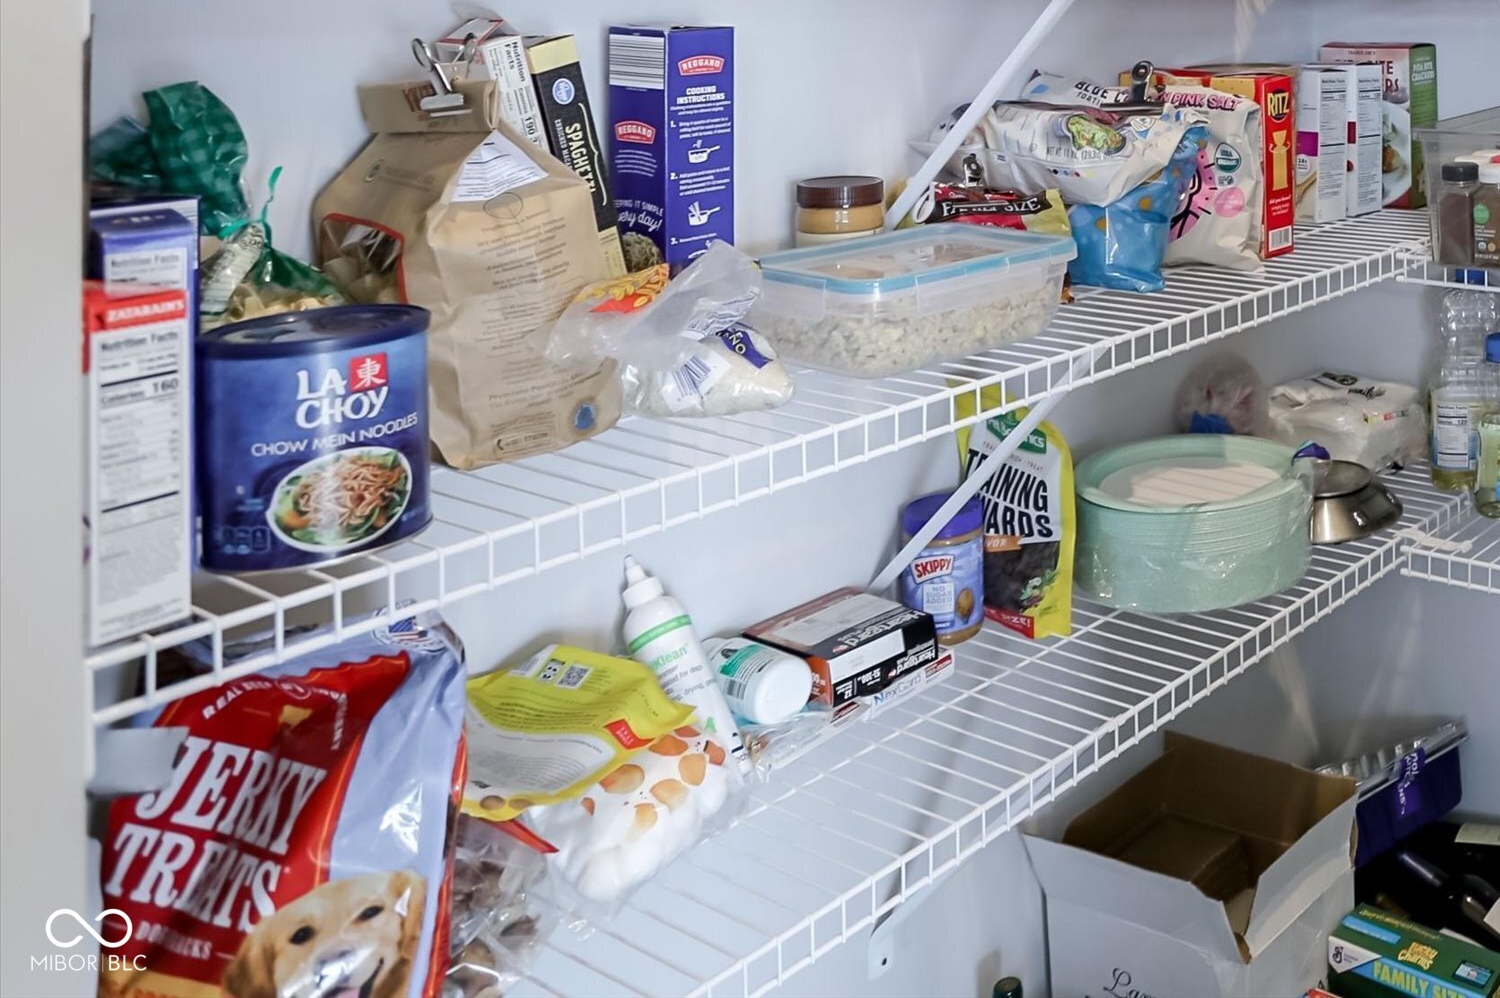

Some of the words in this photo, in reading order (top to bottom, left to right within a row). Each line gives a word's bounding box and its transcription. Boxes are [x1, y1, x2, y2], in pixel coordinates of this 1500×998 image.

[504, 43, 515, 71] Facts
[511, 40, 526, 83] Nutrition
[676, 92, 726, 105] INSTRUCTIONS
[686, 85, 717, 96] COOKING
[1170, 92, 1205, 109] PINK
[1207, 94, 1241, 112] SALT
[1267, 91, 1291, 117] RITZ
[524, 115, 537, 136] 190
[642, 201, 665, 217] SIMPLE
[101, 336, 147, 352] Nutrition
[151, 330, 179, 343] Facts
[152, 378, 179, 393] 160
[296, 368, 347, 400] LA
[351, 357, 387, 391] 東
[295, 386, 389, 430] CHOY
[251, 439, 309, 458] CHOW
[312, 430, 356, 452] MEIN
[359, 411, 419, 443] NOODLES
[914, 557, 952, 579] SKIPPY
[201, 686, 242, 720] REAL
[135, 728, 328, 856] JERKY
[104, 822, 284, 934] TREATS
[1371, 959, 1430, 998] FAMILY
